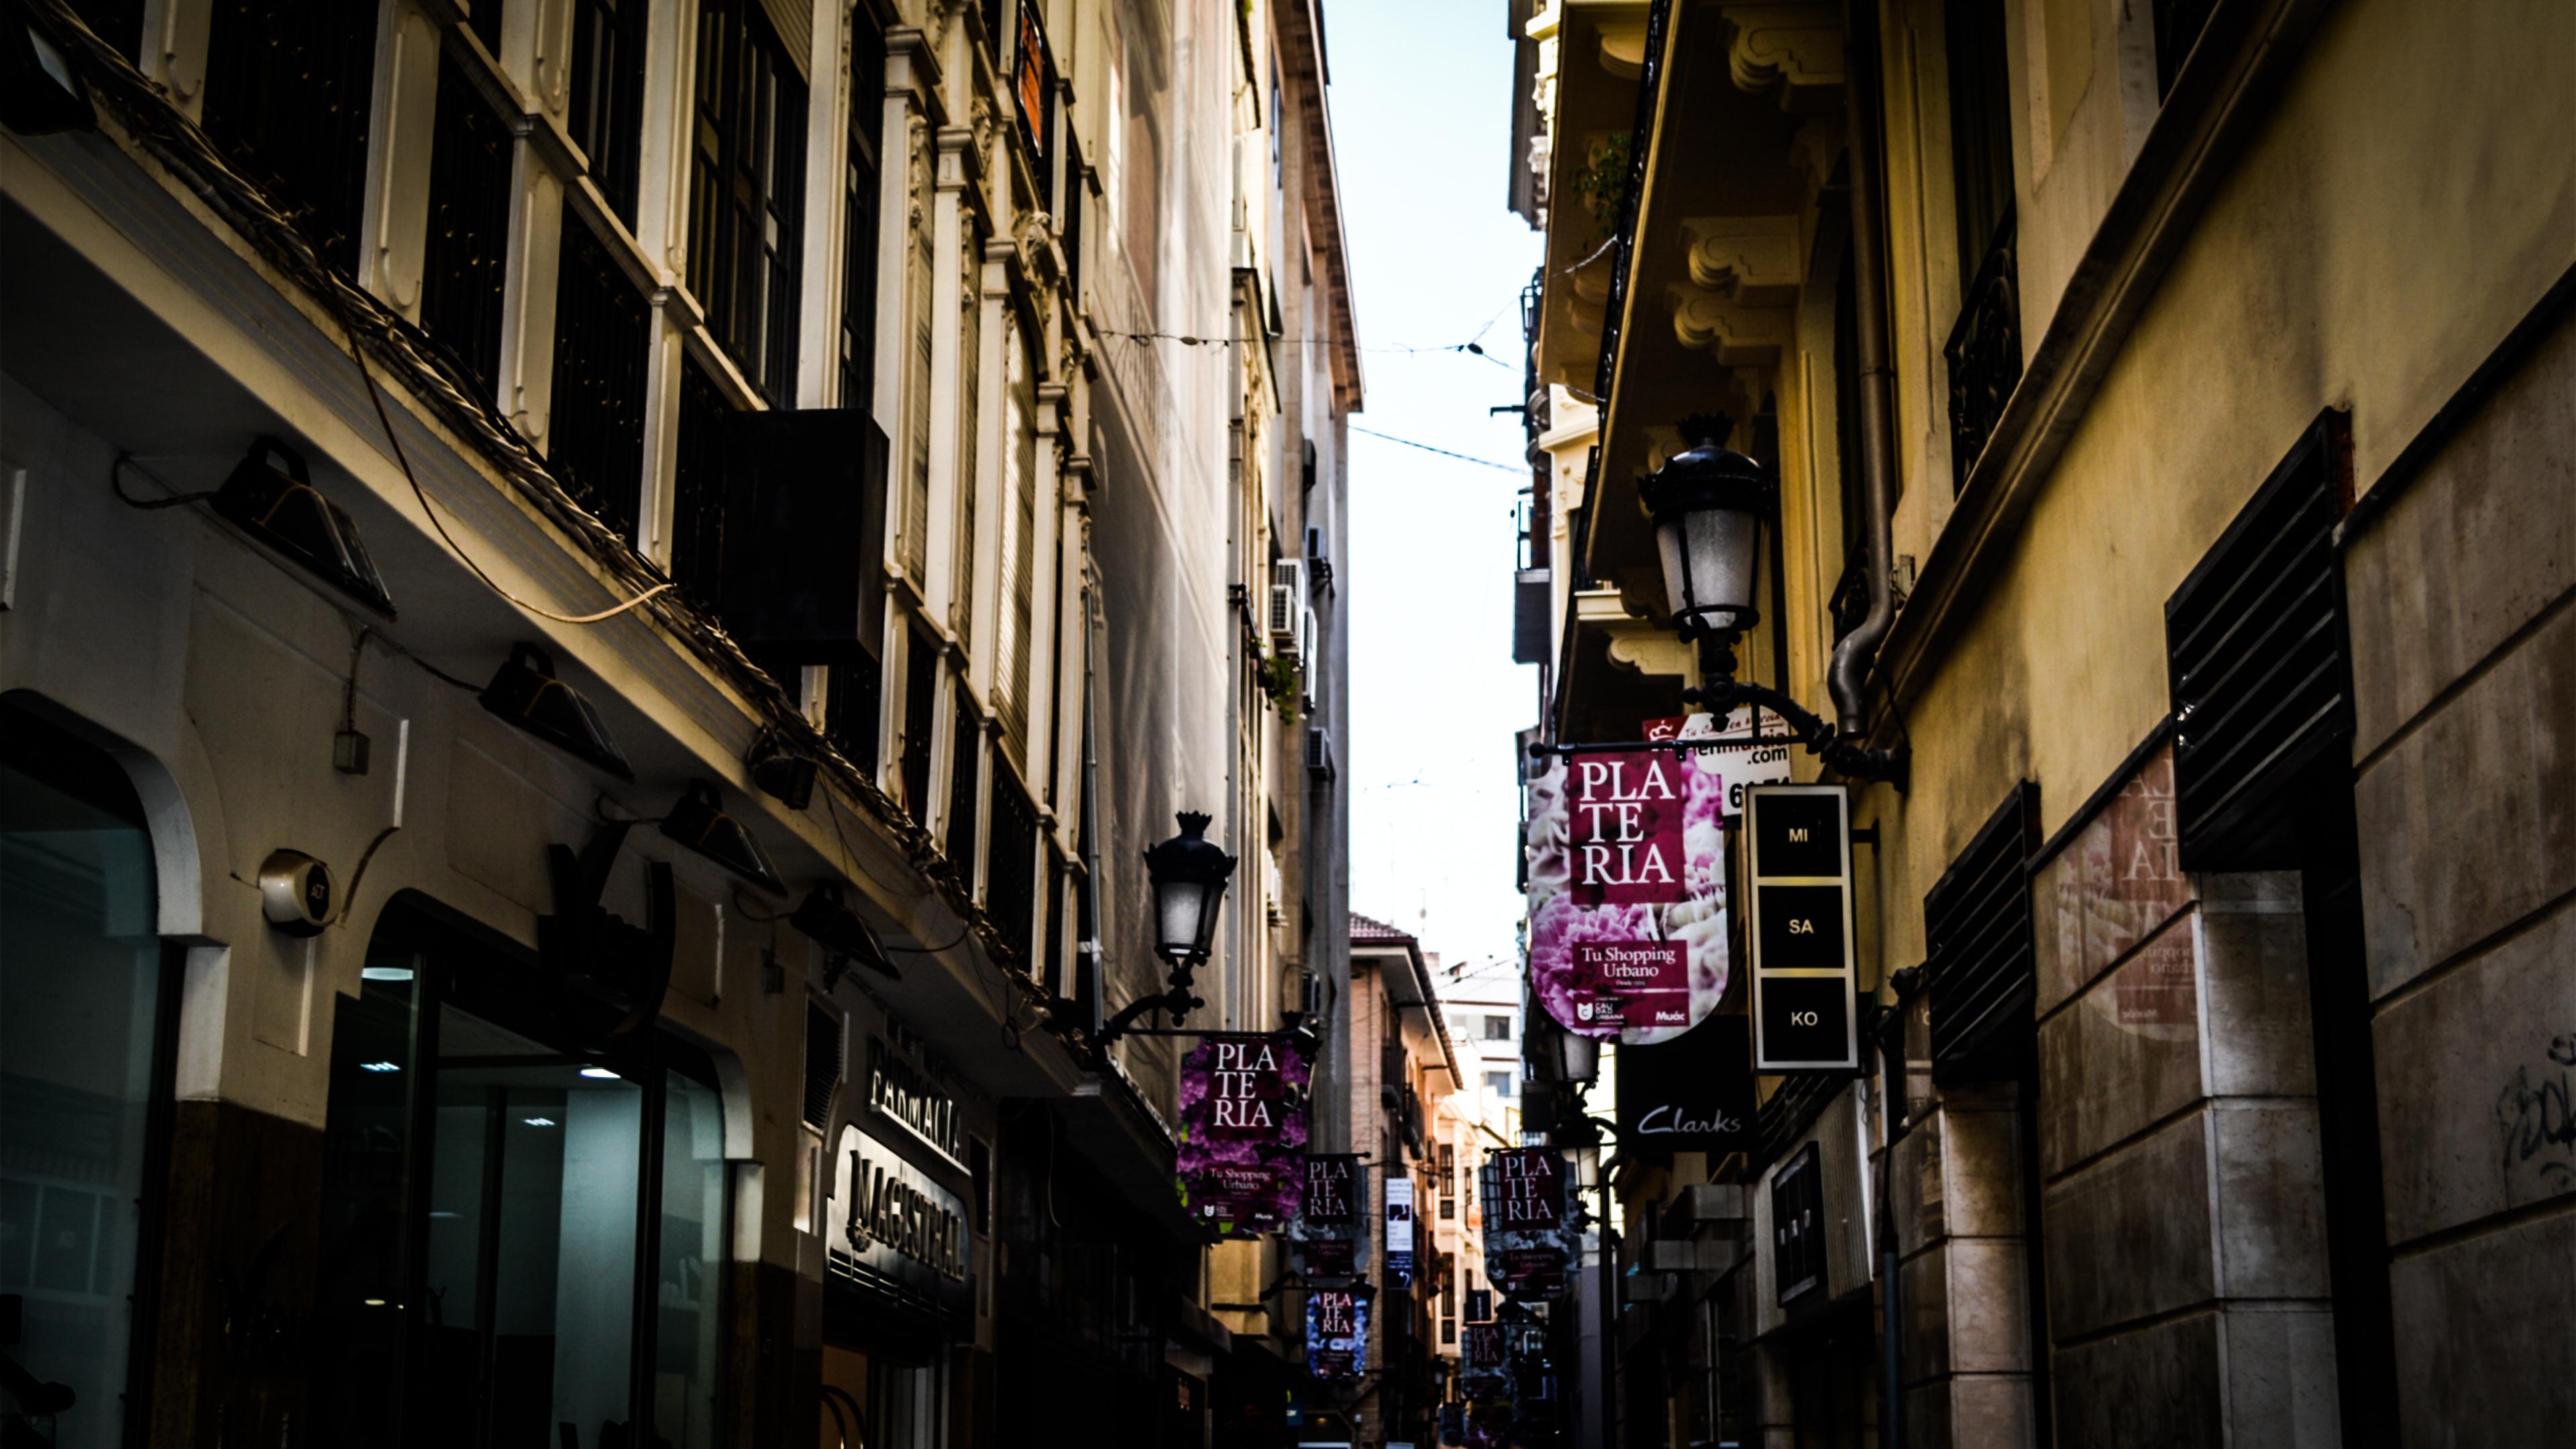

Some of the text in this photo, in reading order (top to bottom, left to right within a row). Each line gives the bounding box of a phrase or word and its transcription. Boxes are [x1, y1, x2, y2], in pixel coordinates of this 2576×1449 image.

[1747, 747, 1787, 765] .com
[1578, 759, 1676, 802] PLA
[1578, 802, 1644, 843] TE
[1788, 828, 1809, 843] MI
[1581, 844, 1676, 885] RIA
[1788, 918, 1815, 935] SA
[1581, 947, 1676, 965] Tu Shopping
[1603, 963, 1660, 978] Urbano
[1790, 1012, 1819, 1027] KO
[1216, 1043, 1279, 1071] PLA
[1215, 1071, 1256, 1099] TE
[1213, 1099, 1274, 1128] RIA
[1638, 1106, 1741, 1134] Clarks
[1309, 1161, 1348, 1179] PLA
[1505, 1155, 1553, 1177] PLA
[1308, 1179, 1336, 1197] TE
[1504, 1177, 1538, 1199] TE
[1309, 1197, 1348, 1216] RIA
[1507, 1198, 1554, 1221] RIA
[1322, 1292, 1352, 1307] PLA
[1322, 1305, 1344, 1320] TE
[1322, 1319, 1350, 1334] RIA
